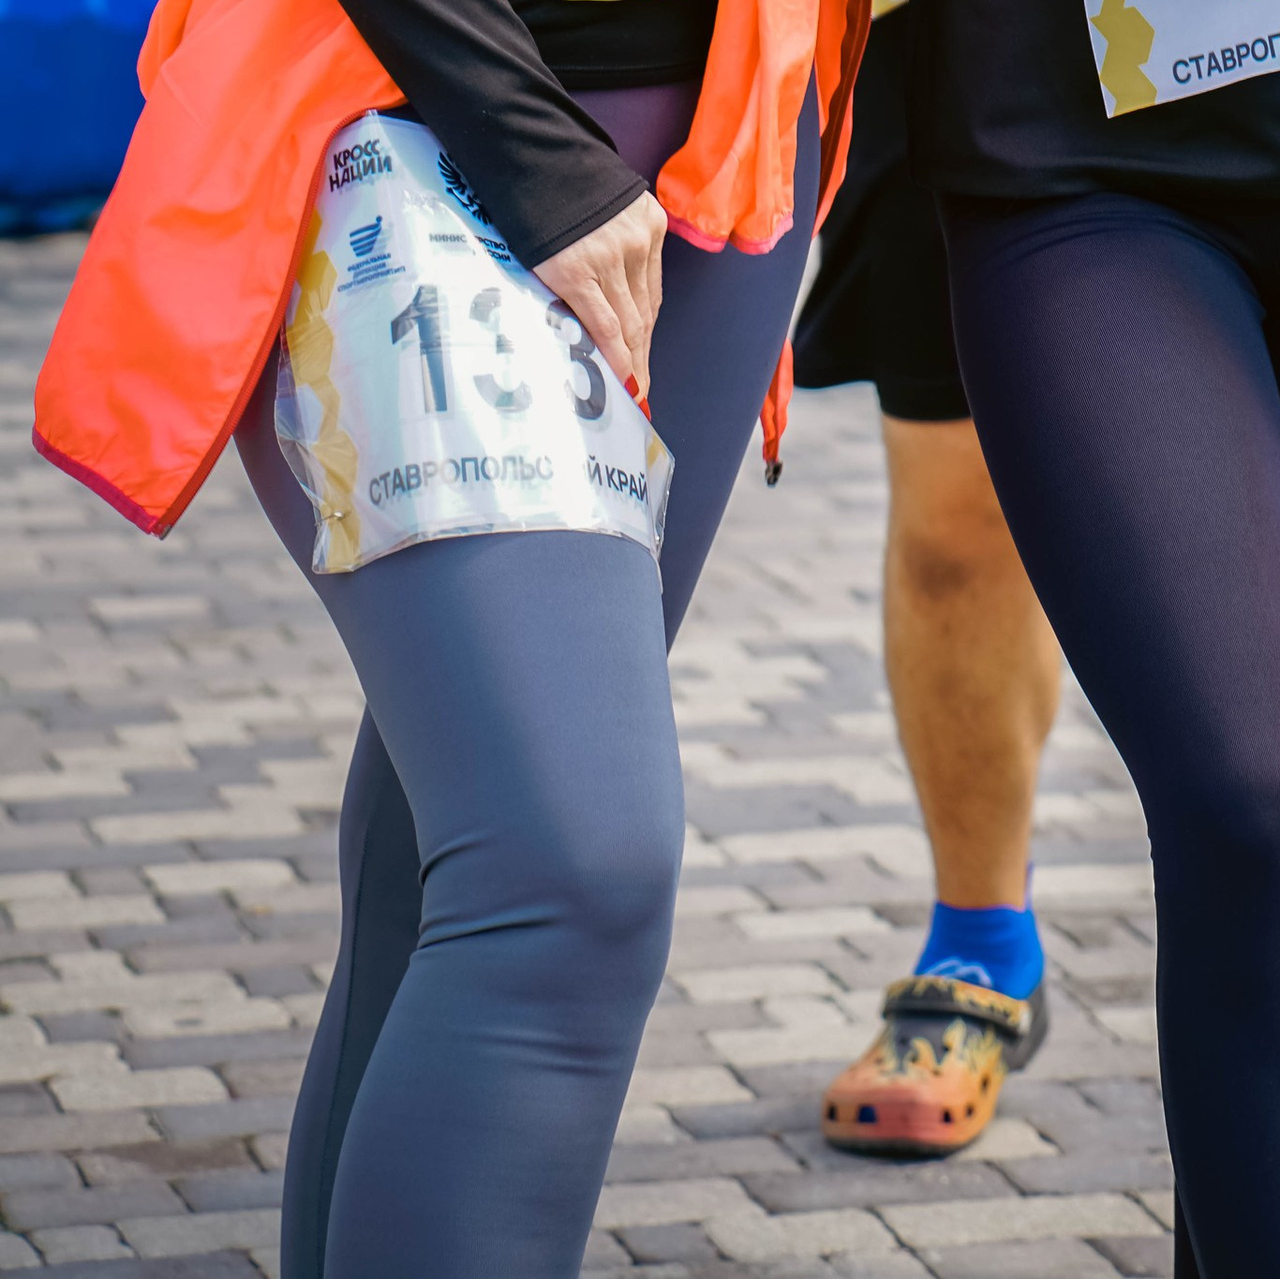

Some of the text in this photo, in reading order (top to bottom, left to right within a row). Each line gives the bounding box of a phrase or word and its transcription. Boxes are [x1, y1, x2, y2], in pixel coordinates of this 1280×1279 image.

[333, 139, 380, 170] КРОСС
[329, 155, 392, 192] НАЦИИ
[605, 465, 649, 505] КРАЙ
